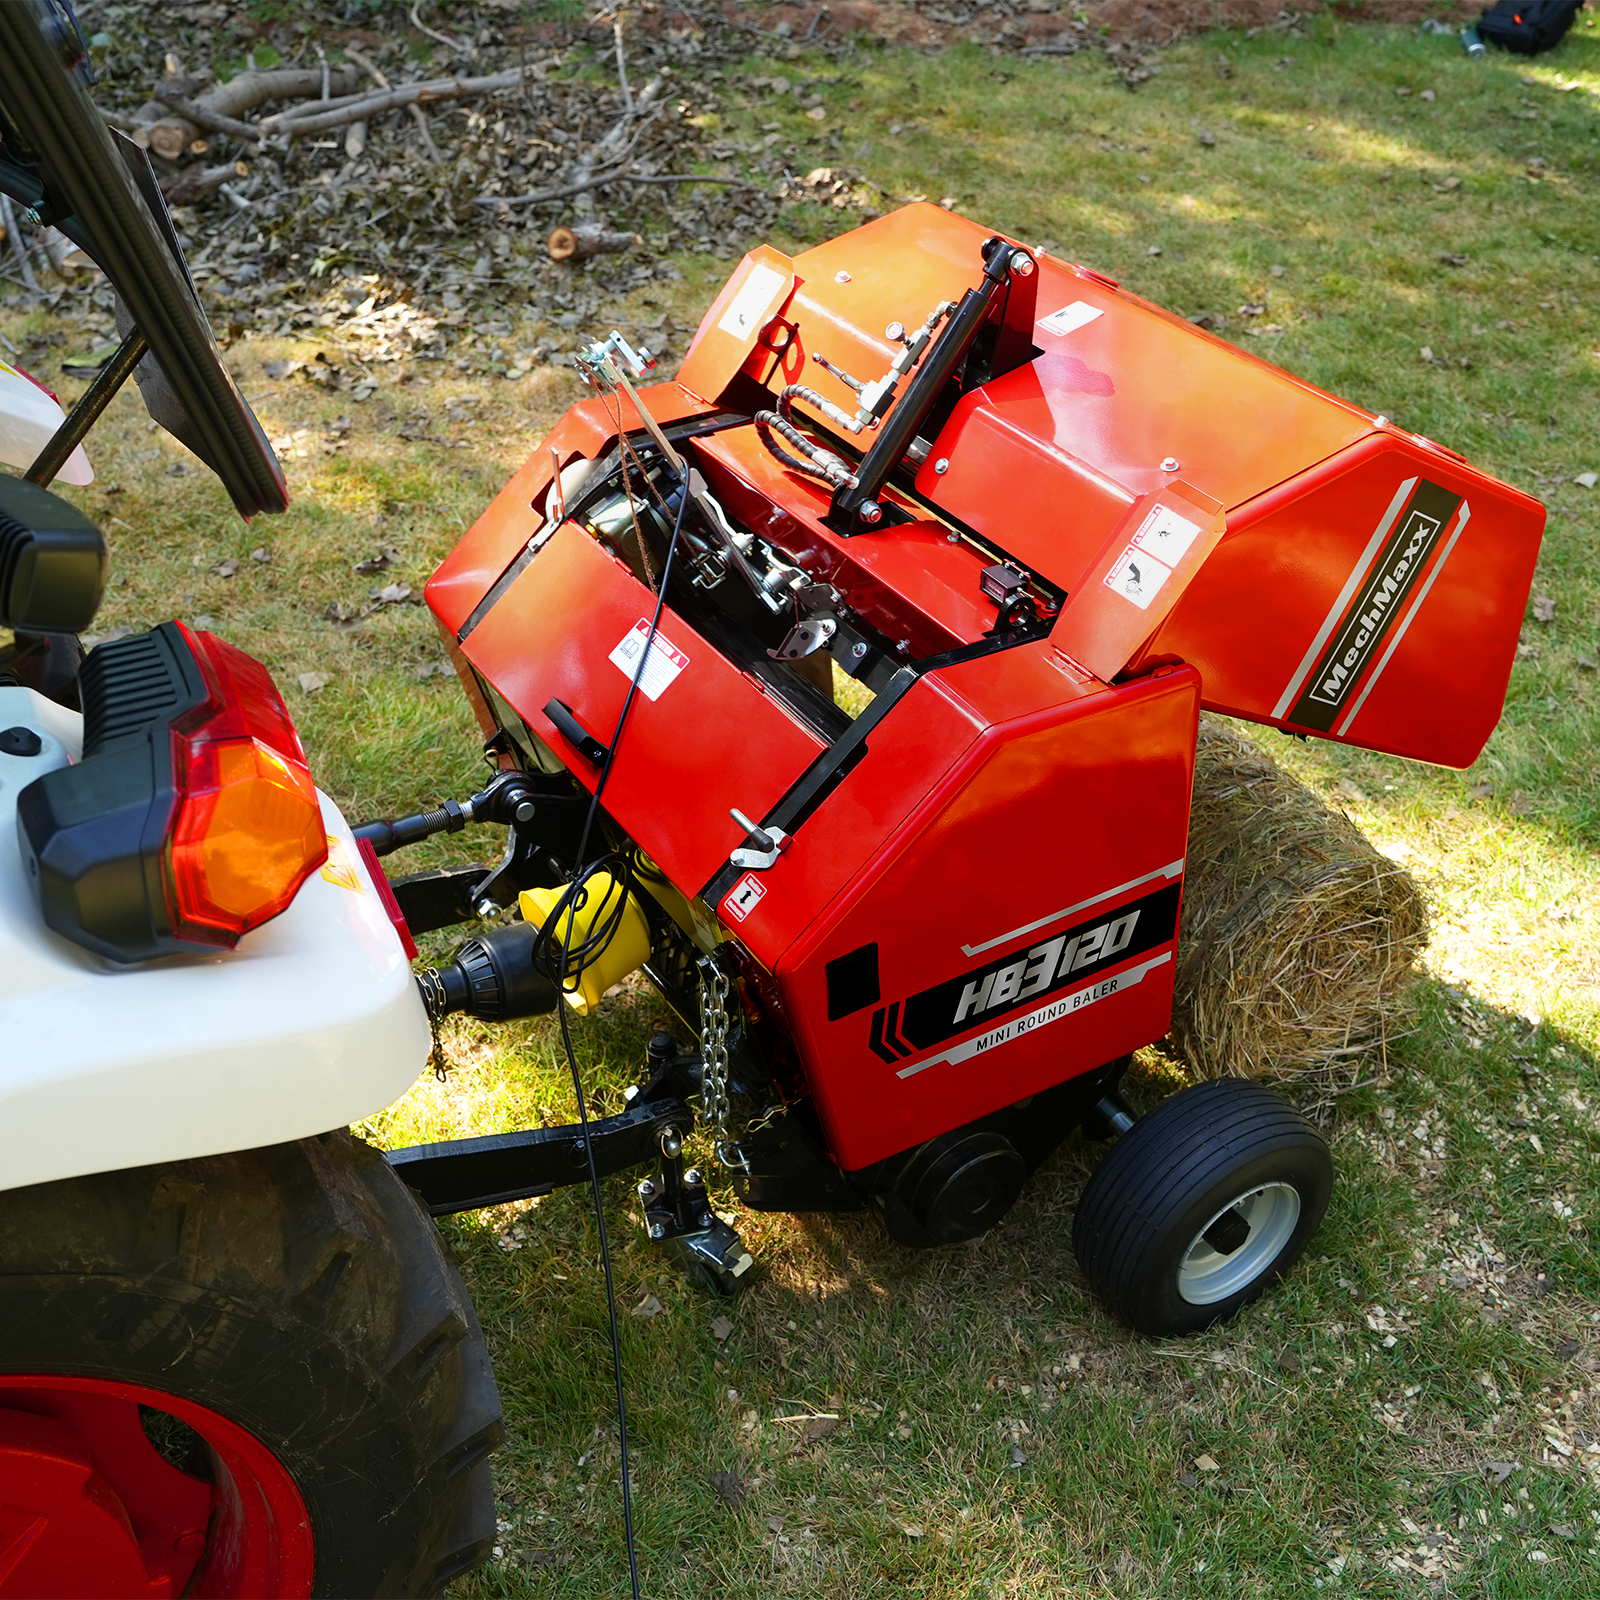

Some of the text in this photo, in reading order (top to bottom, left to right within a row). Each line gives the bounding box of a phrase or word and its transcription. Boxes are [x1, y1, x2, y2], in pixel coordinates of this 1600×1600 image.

[1322, 522, 1430, 698] MechMaxx
[952, 909, 1142, 1025] HB3120
[976, 979, 1119, 1052] MINI ROUND BALER
